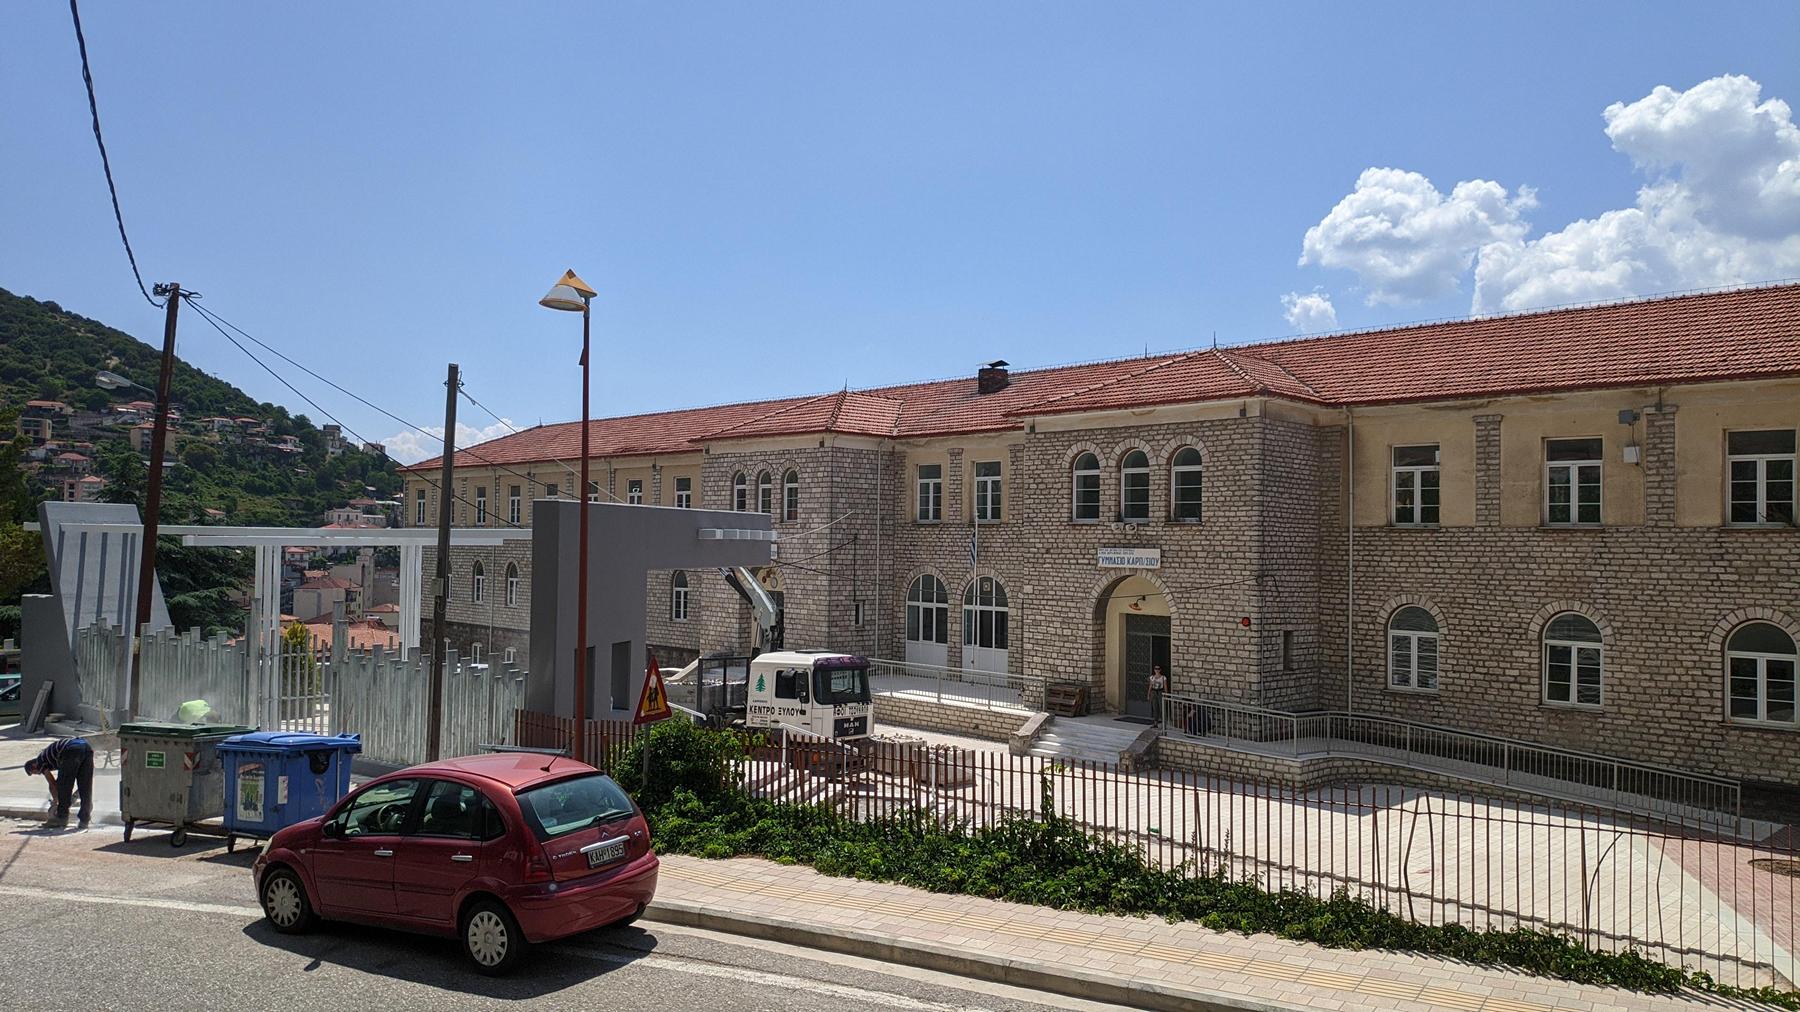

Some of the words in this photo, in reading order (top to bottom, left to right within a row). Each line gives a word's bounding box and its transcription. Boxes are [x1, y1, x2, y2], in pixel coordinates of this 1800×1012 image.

[749, 705, 776, 715] ΚΕΝΤΡΟ
[778, 706, 800, 717] ΞΥΛΟΥ
[843, 721, 860, 729] MAN
